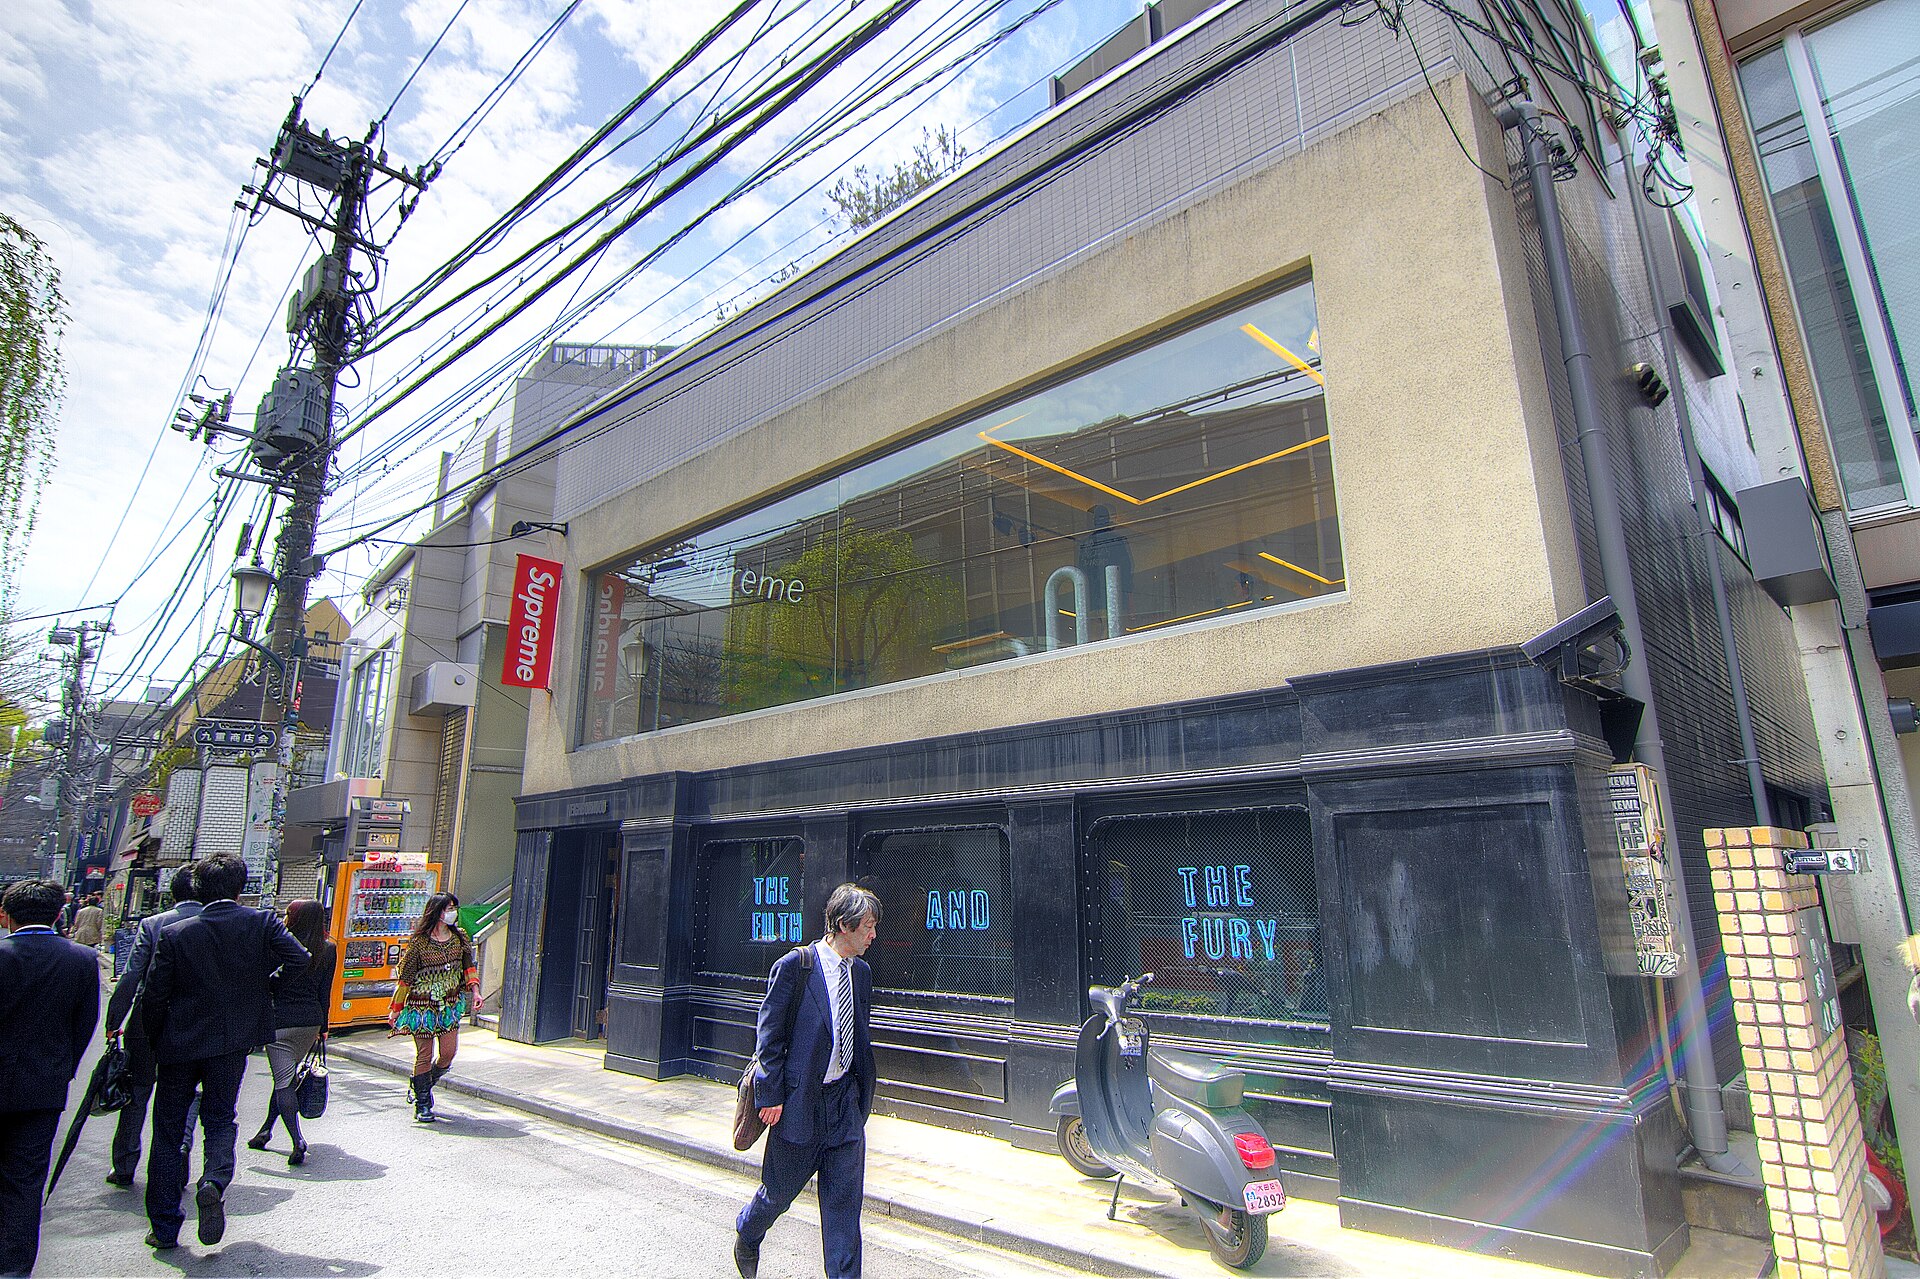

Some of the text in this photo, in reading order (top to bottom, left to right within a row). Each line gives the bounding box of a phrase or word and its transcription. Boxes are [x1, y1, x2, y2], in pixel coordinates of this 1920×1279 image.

[684, 546, 804, 603] upreme
[516, 565, 555, 682] Supreme
[753, 876, 790, 906] THE
[1178, 865, 1255, 908] THE
[751, 911, 803, 943] FILTH
[925, 889, 991, 931] AND
[1181, 917, 1277, 961] FURY
